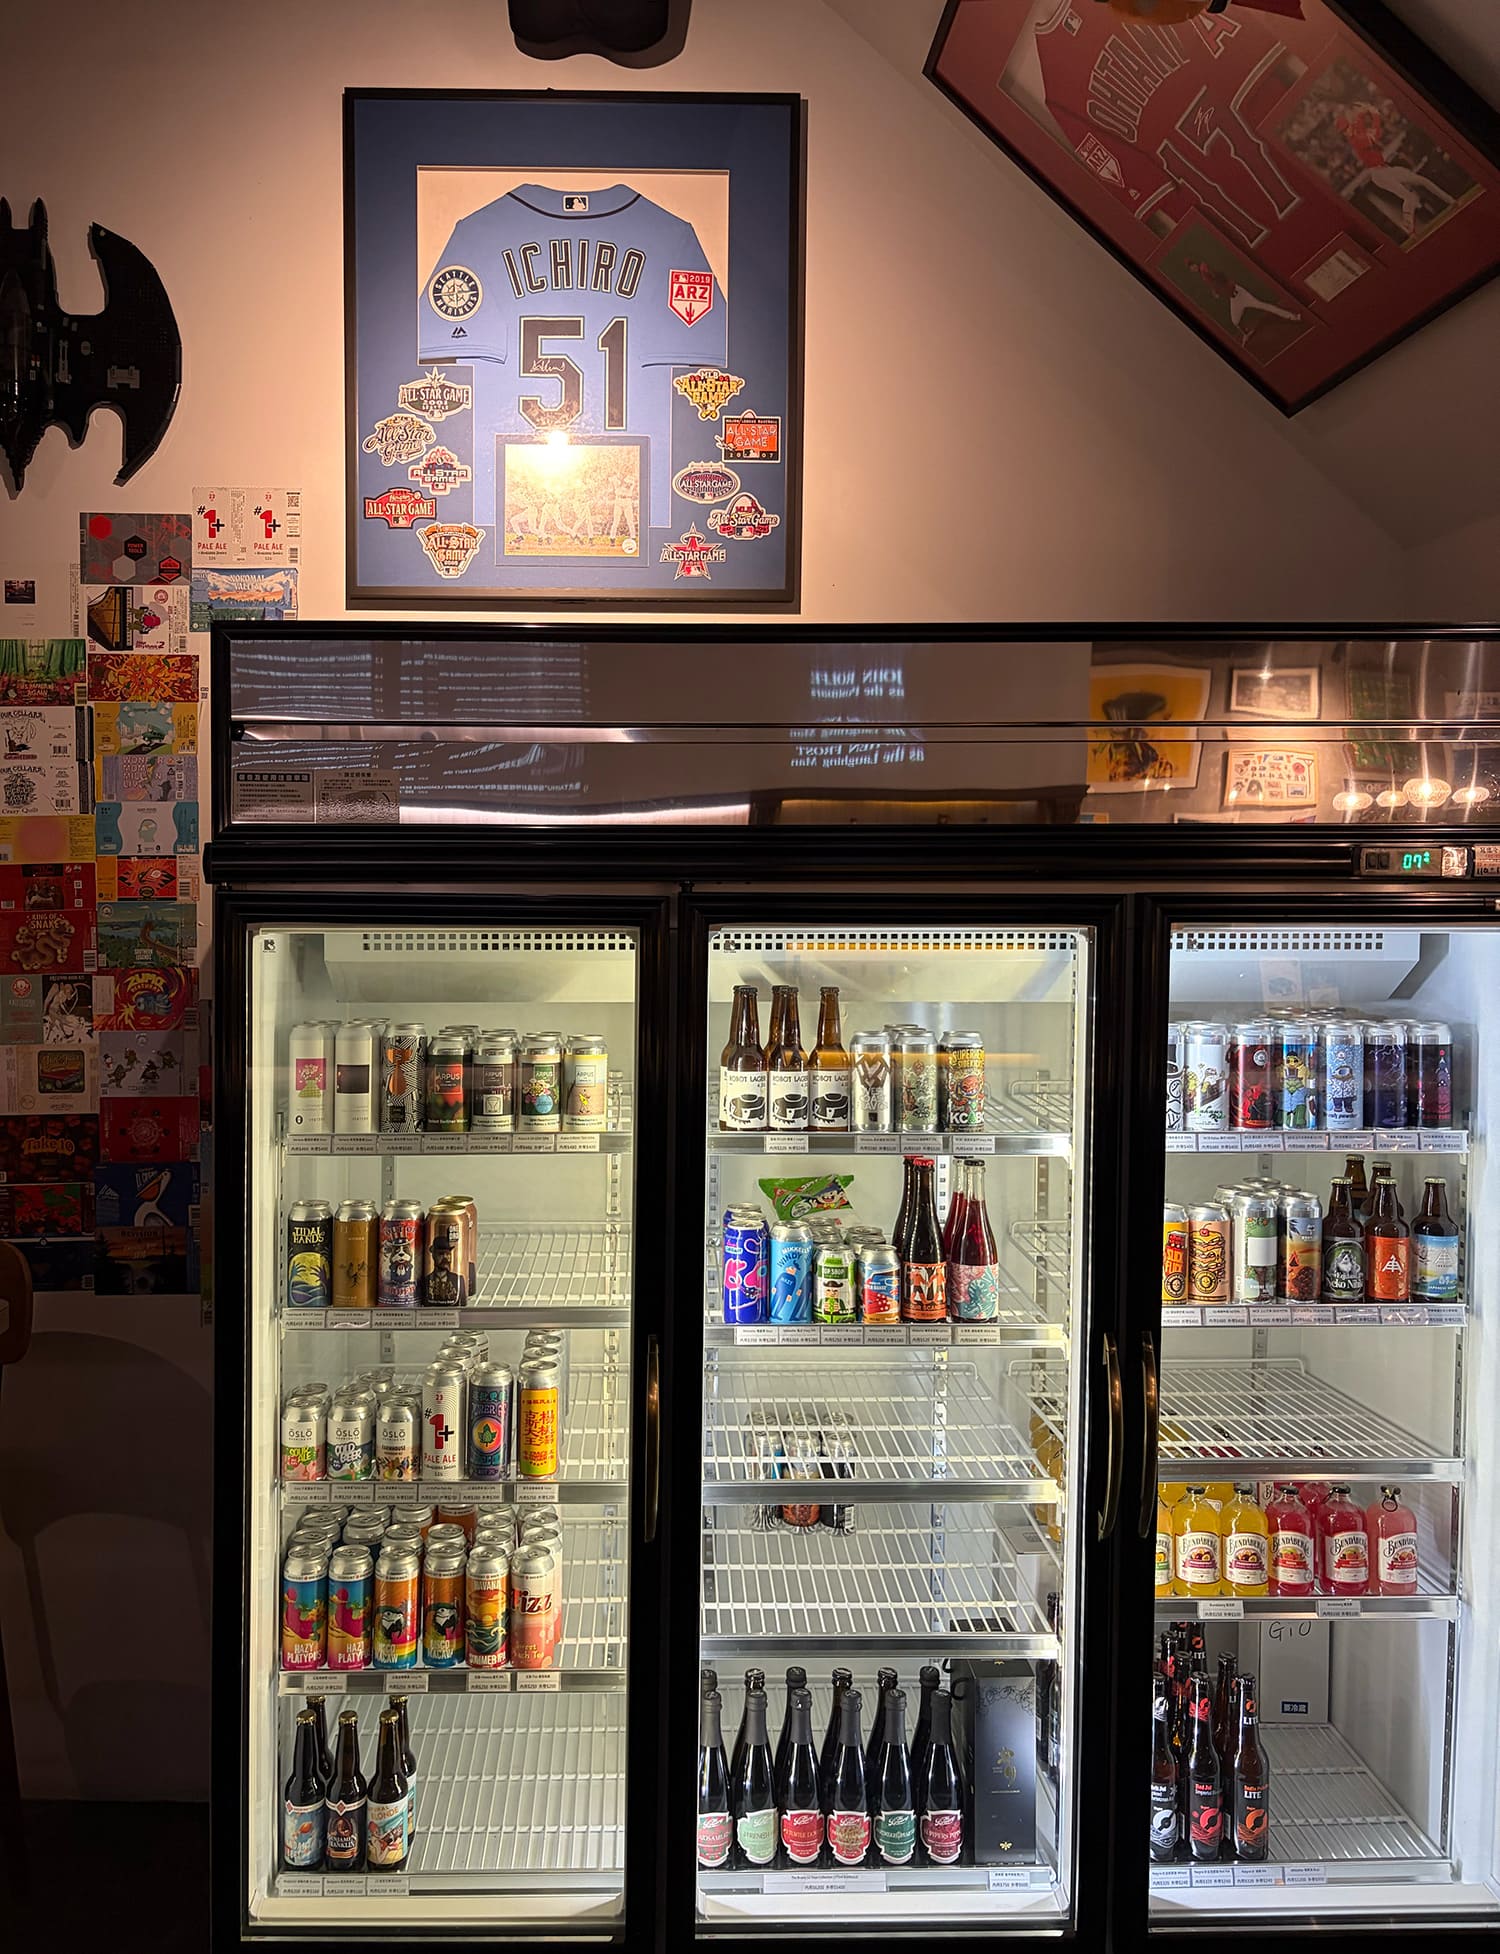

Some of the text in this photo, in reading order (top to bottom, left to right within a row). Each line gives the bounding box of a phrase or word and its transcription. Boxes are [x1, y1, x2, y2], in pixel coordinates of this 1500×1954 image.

[1156, 84, 1300, 249] 17
[501, 239, 647, 300] ICHIRO
[435, 270, 476, 290] SEATTLE
[674, 284, 709, 301] ARZ
[434, 294, 478, 318] MARINERS
[519, 315, 629, 432] 51
[443, 387, 469, 403] GAME
[692, 391, 727, 404] GAME
[735, 436, 768, 448] GAME
[424, 476, 456, 484] GAME
[709, 479, 734, 488] GAME
[408, 502, 434, 516] GAME
[752, 513, 779, 526] Game
[197, 542, 228, 550] PALE ALE
[253, 542, 284, 550] PALE ALE
[436, 549, 466, 561] GAME
[700, 550, 726, 561] GAME
[294, 1226, 321, 1236] TIDAL
[293, 1233, 324, 1244] HANDS
[777, 1252, 802, 1267] WINDY
[335, 1442, 357, 1455] COLD
[299, 1453, 313, 1462] ALE
[340, 1449, 362, 1463] BEER
[424, 1453, 456, 1464] PALE ALE
[295, 1643, 313, 1654] HAZY
[346, 1642, 365, 1654] HAZY
[1244, 1791, 1263, 1799] LITE
[370, 1807, 399, 1820] BLONDE
